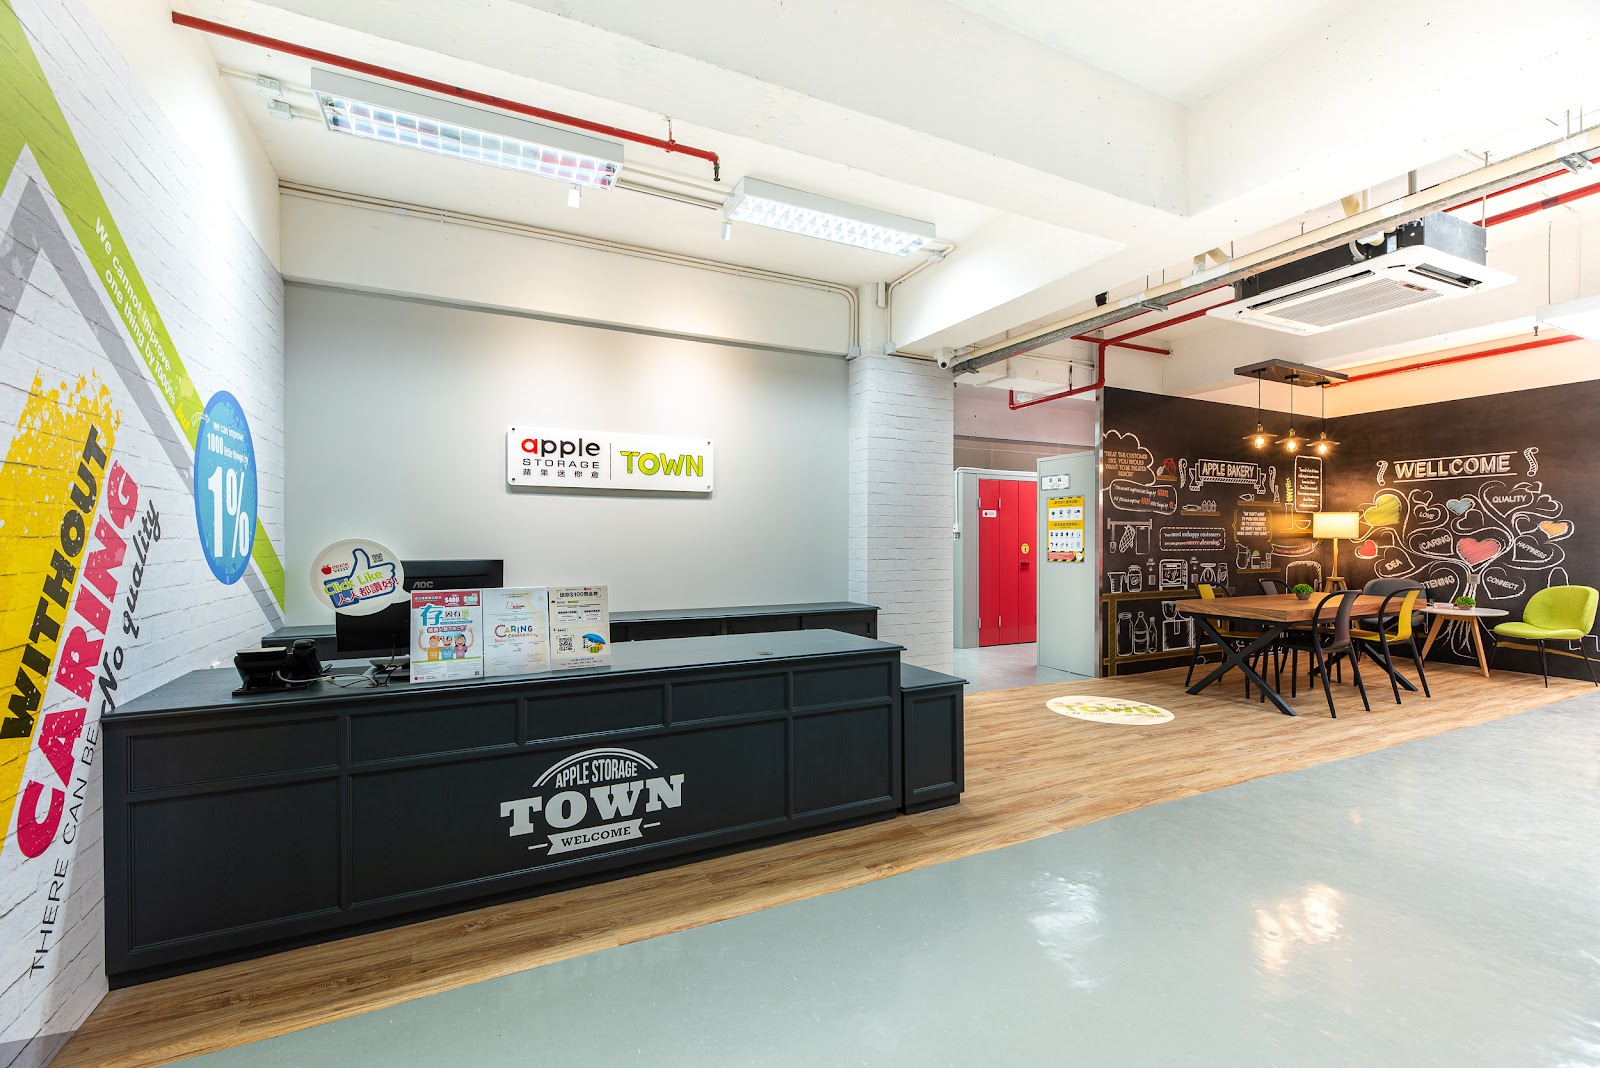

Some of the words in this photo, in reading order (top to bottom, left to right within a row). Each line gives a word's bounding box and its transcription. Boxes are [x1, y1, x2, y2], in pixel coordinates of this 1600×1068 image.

[96, 217, 112, 254] We
[112, 256, 142, 314] cannot
[141, 310, 171, 371] improve
[123, 301, 144, 347] thing
[145, 345, 154, 367] by
[175, 402, 191, 432] but
[220, 424, 229, 434] can
[228, 426, 244, 442] improve
[206, 433, 224, 455] 1000
[223, 446, 232, 459] little
[521, 437, 601, 458] apple
[522, 458, 600, 469] STORAGE
[522, 467, 600, 479] 蘋果迷你倉
[619, 450, 703, 477] TOWN
[1202, 462, 1225, 476] APPLE
[1228, 464, 1255, 479] BAKERY
[1394, 454, 1511, 479] WELLCOME
[1492, 494, 1527, 504] QUALITY
[207, 465, 250, 558] 1%
[1419, 511, 1435, 520] LOVE
[1421, 533, 1451, 551] CARING
[1516, 540, 1548, 559] HAPPINESS
[1384, 558, 1403, 571] IDEA
[0, 423, 107, 740] WITHOUT
[324, 578, 355, 596] Click
[356, 571, 382, 585] Like
[412, 581, 433, 589] AOC
[1486, 575, 1520, 591] CONNECT
[494, 624, 533, 638] CARING
[17, 459, 139, 859] CARING
[29, 857, 70, 979] THERE
[62, 777, 88, 845] CAN
[81, 725, 100, 767] BE
[102, 645, 123, 714] No
[123, 499, 161, 640] quality
[555, 761, 590, 789] APPLE
[591, 758, 638, 783] STORAGE
[500, 773, 685, 837] TOWN
[560, 826, 631, 848] WELCOME
